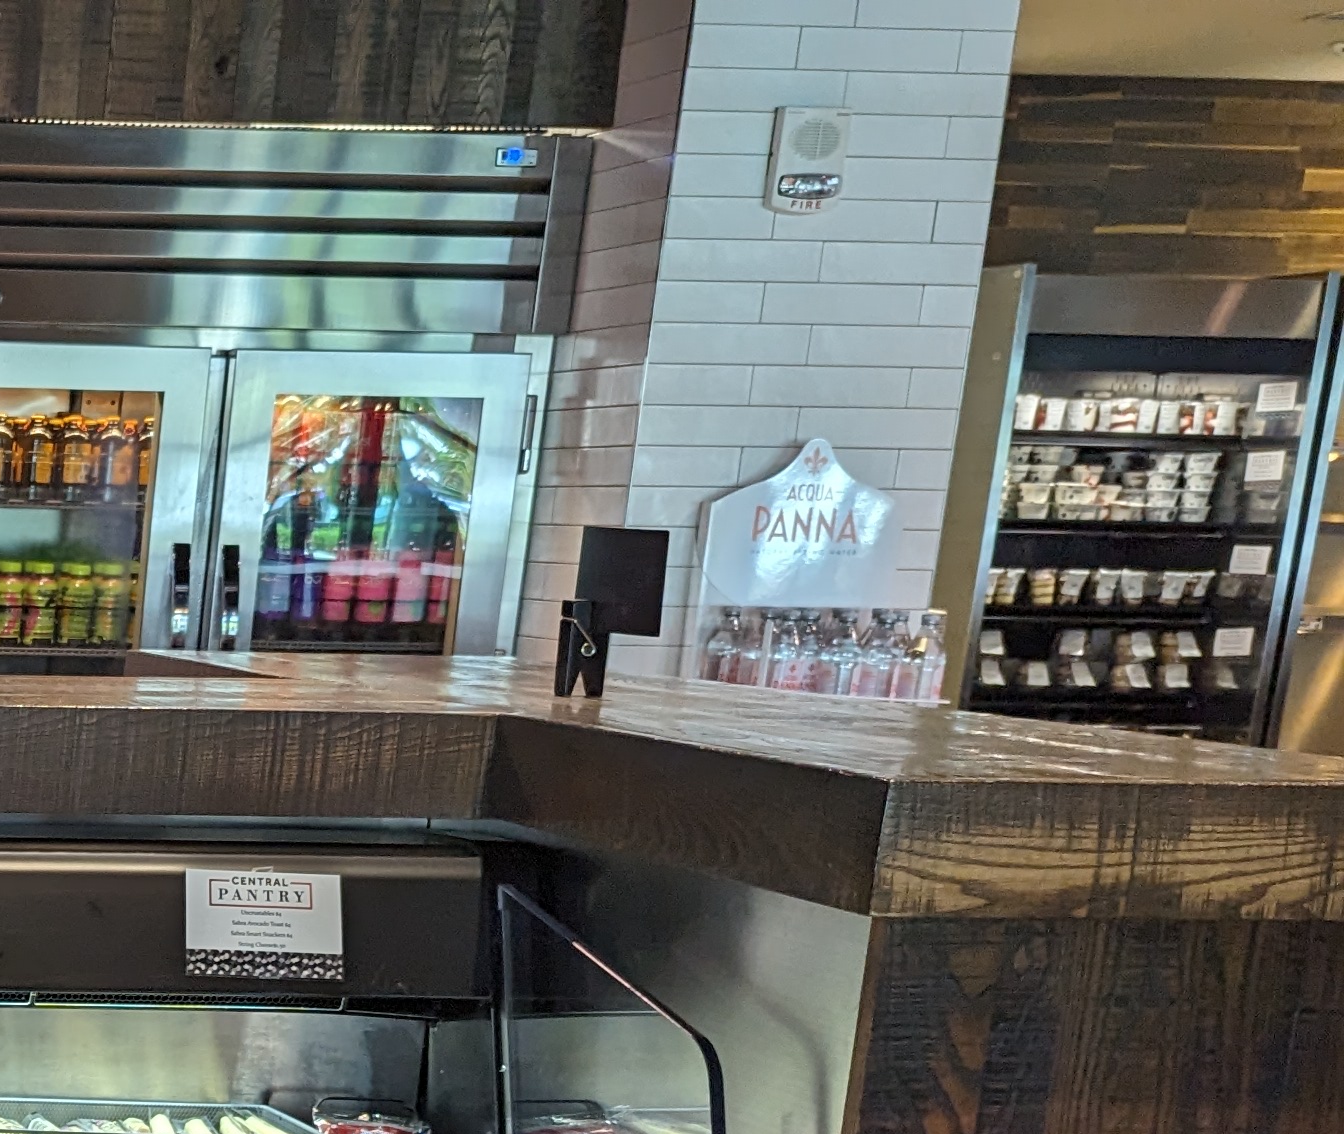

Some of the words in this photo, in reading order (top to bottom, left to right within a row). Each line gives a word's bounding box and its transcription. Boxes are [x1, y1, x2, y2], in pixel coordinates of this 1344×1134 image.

[791, 199, 822, 210] FIRE
[786, 483, 834, 502] ACQUA
[751, 505, 857, 544] PANNA
[231, 876, 289, 887] CENTRAL
[217, 888, 305, 903] PANTRY
